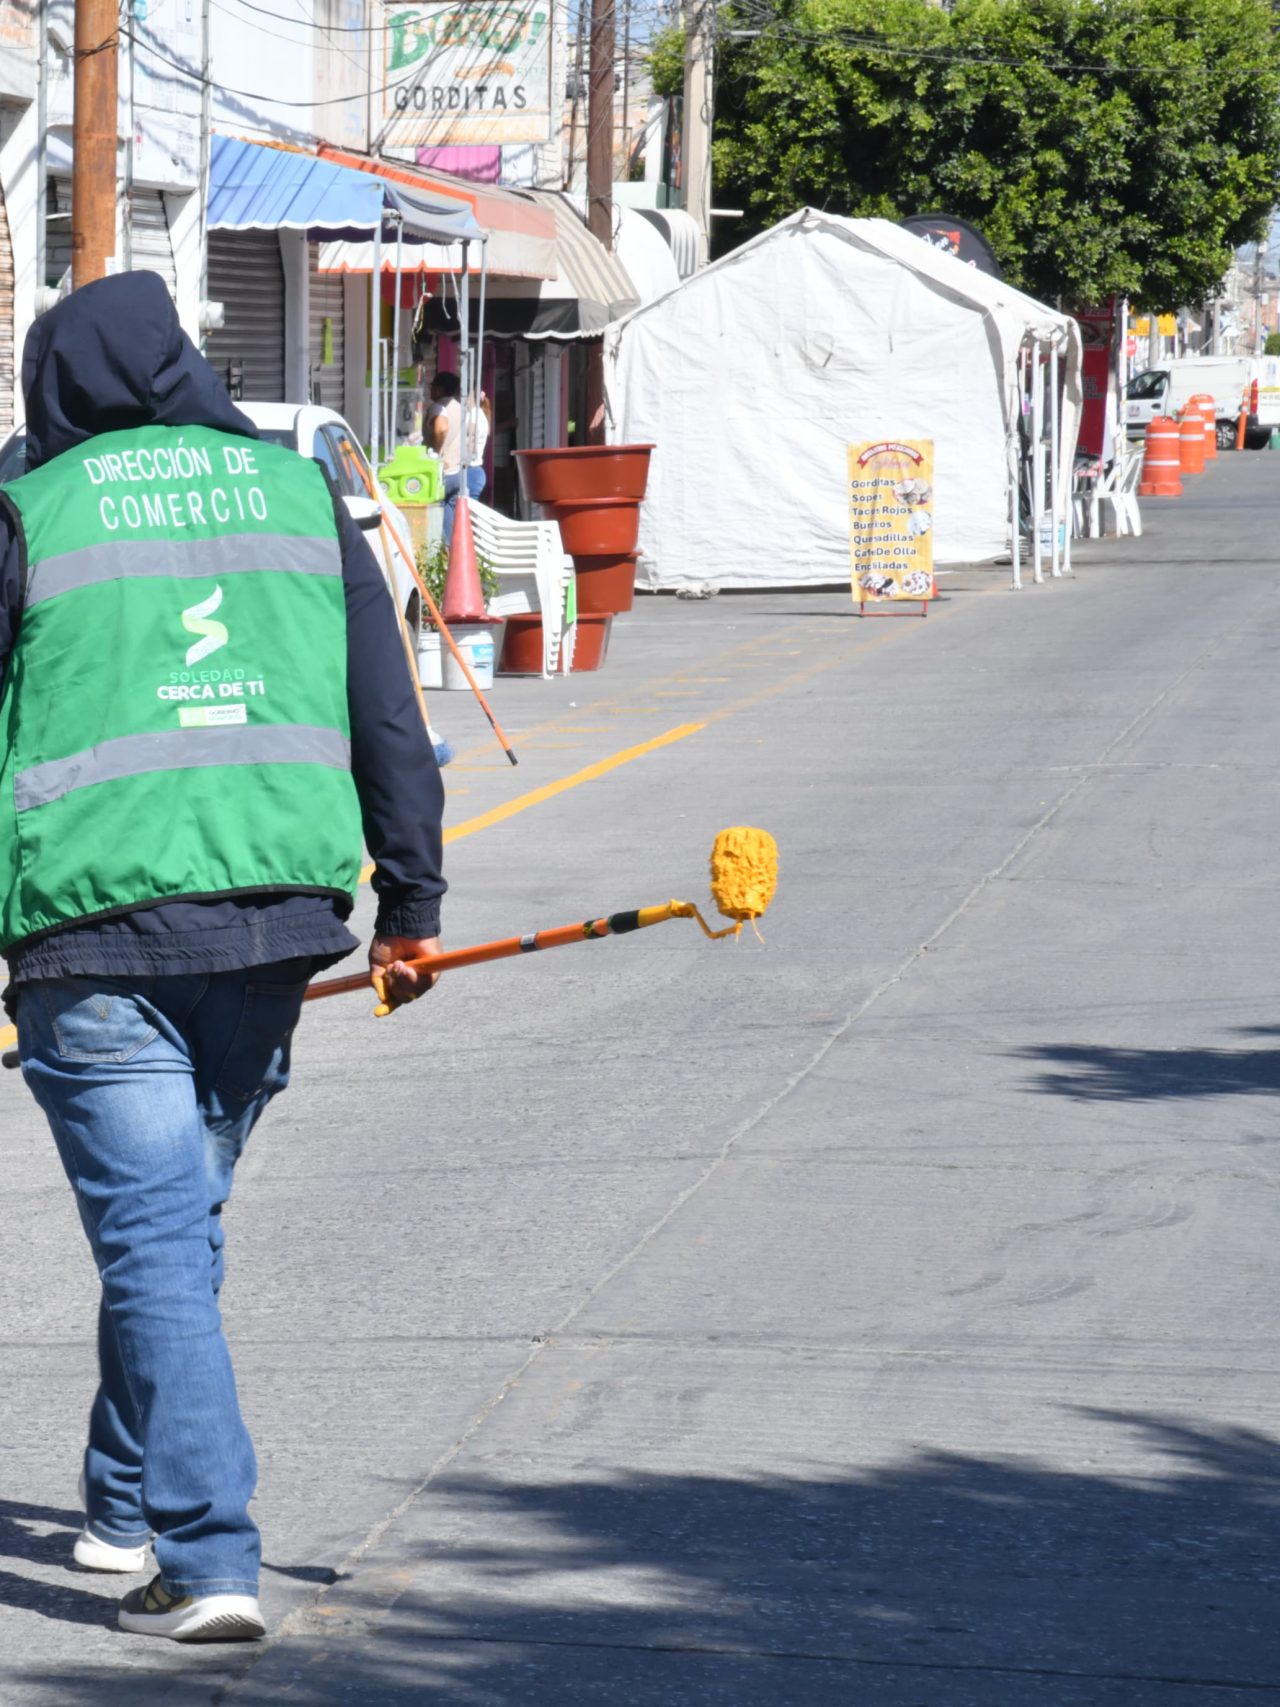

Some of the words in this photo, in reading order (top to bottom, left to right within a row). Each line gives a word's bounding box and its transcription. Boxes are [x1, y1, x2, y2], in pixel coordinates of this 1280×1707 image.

[394, 86, 527, 111] GORDITAS
[83, 437, 213, 484] DIRECCIÓN
[222, 446, 259, 474] DE
[851, 478, 895, 488] Gorditas
[99, 487, 267, 530] COMERCIO
[882, 505, 913, 515] Rojos
[853, 534, 914, 545] Quesadillas
[876, 547, 890, 556] De
[893, 547, 916, 555] Olla
[169, 668, 245, 684] SOLEDAD
[157, 684, 215, 700] CERCA
[218, 682, 244, 697] DE
